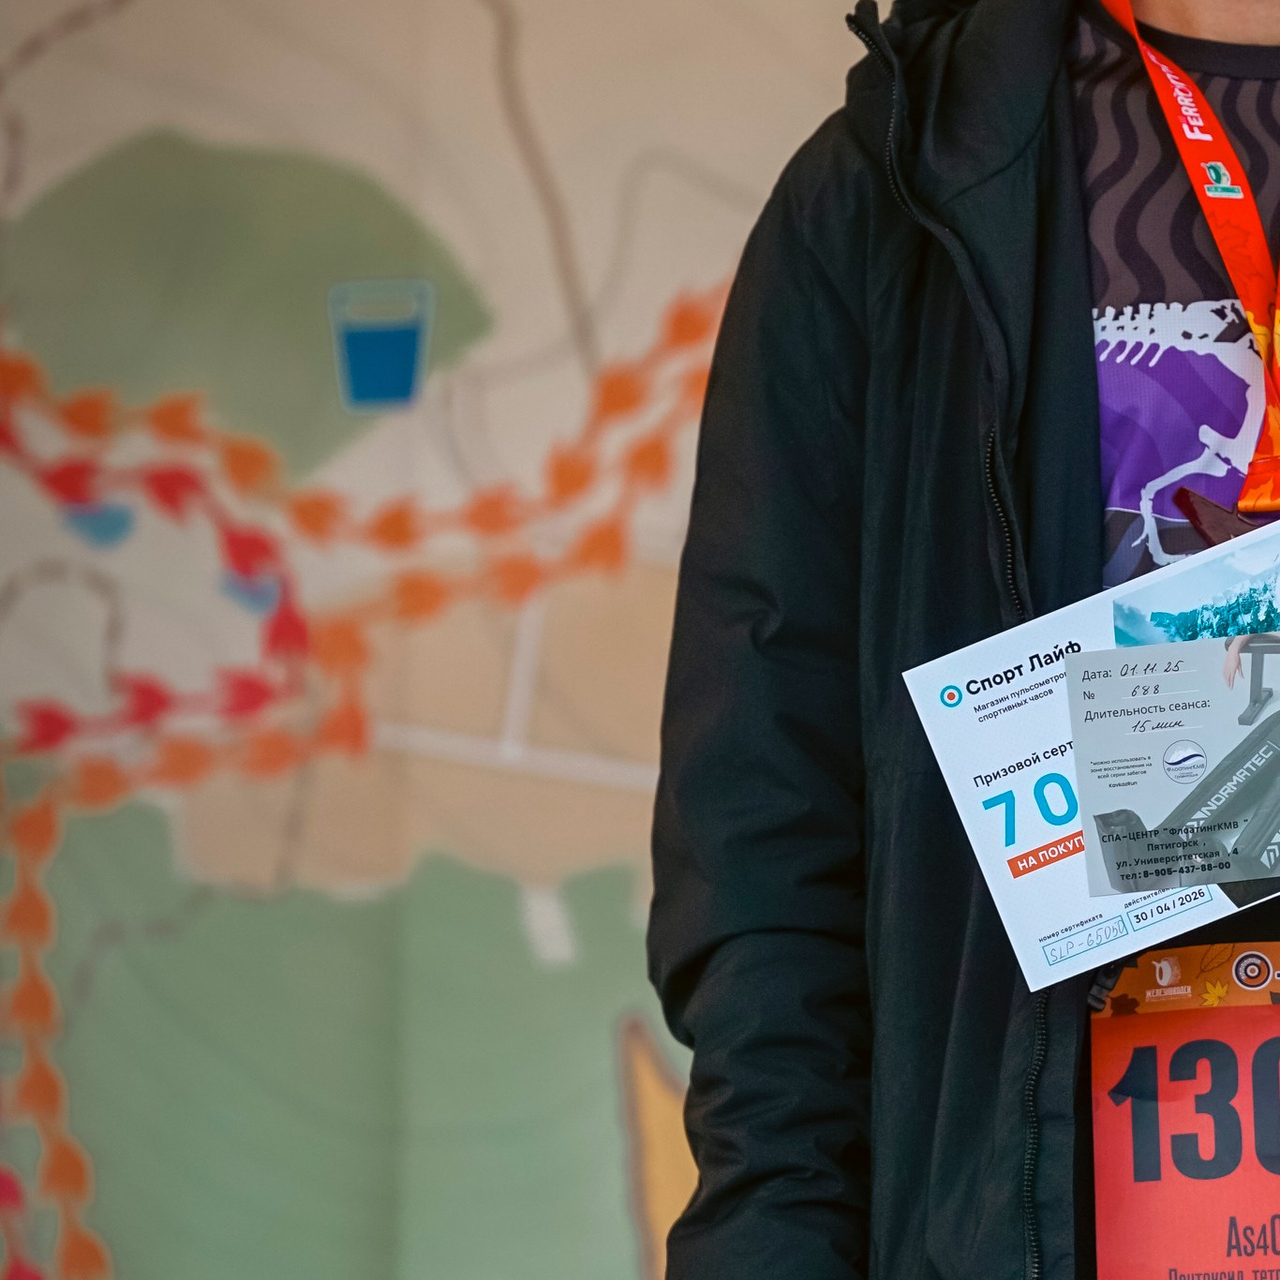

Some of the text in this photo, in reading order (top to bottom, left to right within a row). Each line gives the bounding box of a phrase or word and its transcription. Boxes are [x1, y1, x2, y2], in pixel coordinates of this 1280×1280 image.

[966, 641, 1081, 695] Спорт Лайф
[1082, 670, 1112, 683] Дата:
[973, 695, 1010, 713] Магазин
[1083, 691, 1095, 700] №
[1131, 685, 1160, 697] 688
[978, 688, 1054, 723] спортивных часов
[1084, 699, 1211, 722] Длительность сеанса:
[1131, 720, 1185, 733] 15 мин
[973, 740, 1074, 788] Призовой серт
[1202, 744, 1274, 817] NORMATEC
[982, 773, 1079, 848] 70
[1101, 829, 1159, 843] СПА-ЦЕНТР
[1147, 839, 1199, 852] Пятигорск
[1017, 836, 1085, 871] НА ПОКУП
[1134, 912, 1148, 924] 30
[1156, 903, 1171, 915] 04
[1178, 889, 1205, 906] 2026
[1039, 913, 1104, 943] номер сертификата
